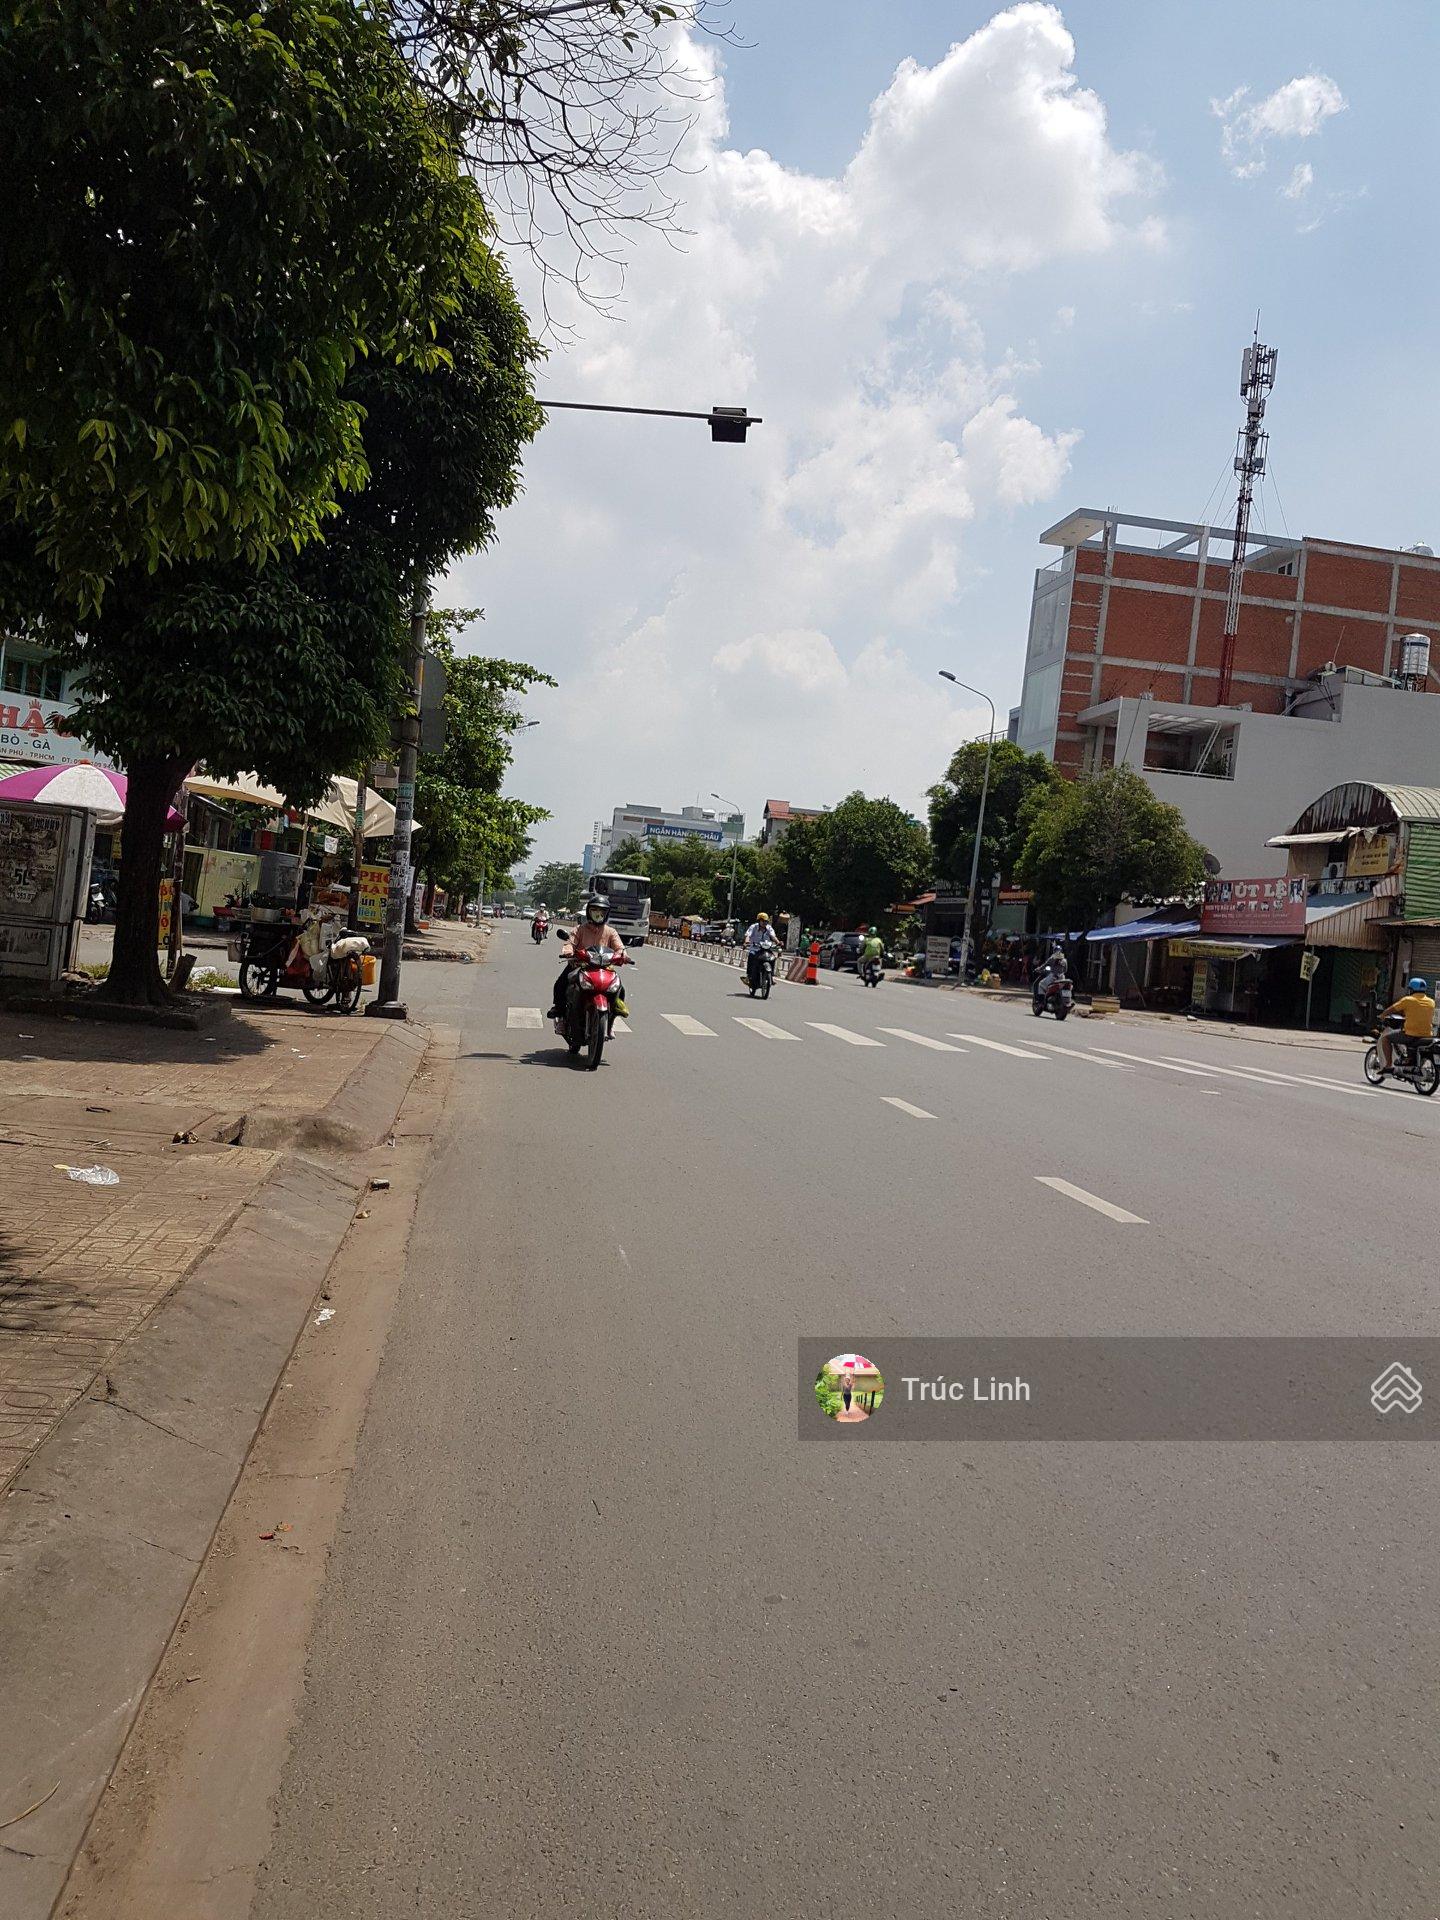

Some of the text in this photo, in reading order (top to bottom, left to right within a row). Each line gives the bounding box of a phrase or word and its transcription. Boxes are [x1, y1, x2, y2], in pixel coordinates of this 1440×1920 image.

[1, 733, 20, 746] BÒ
[32, 739, 51, 751] GÀ
[649, 826, 671, 836] NGÂN
[1263, 879, 1288, 899] LỆ
